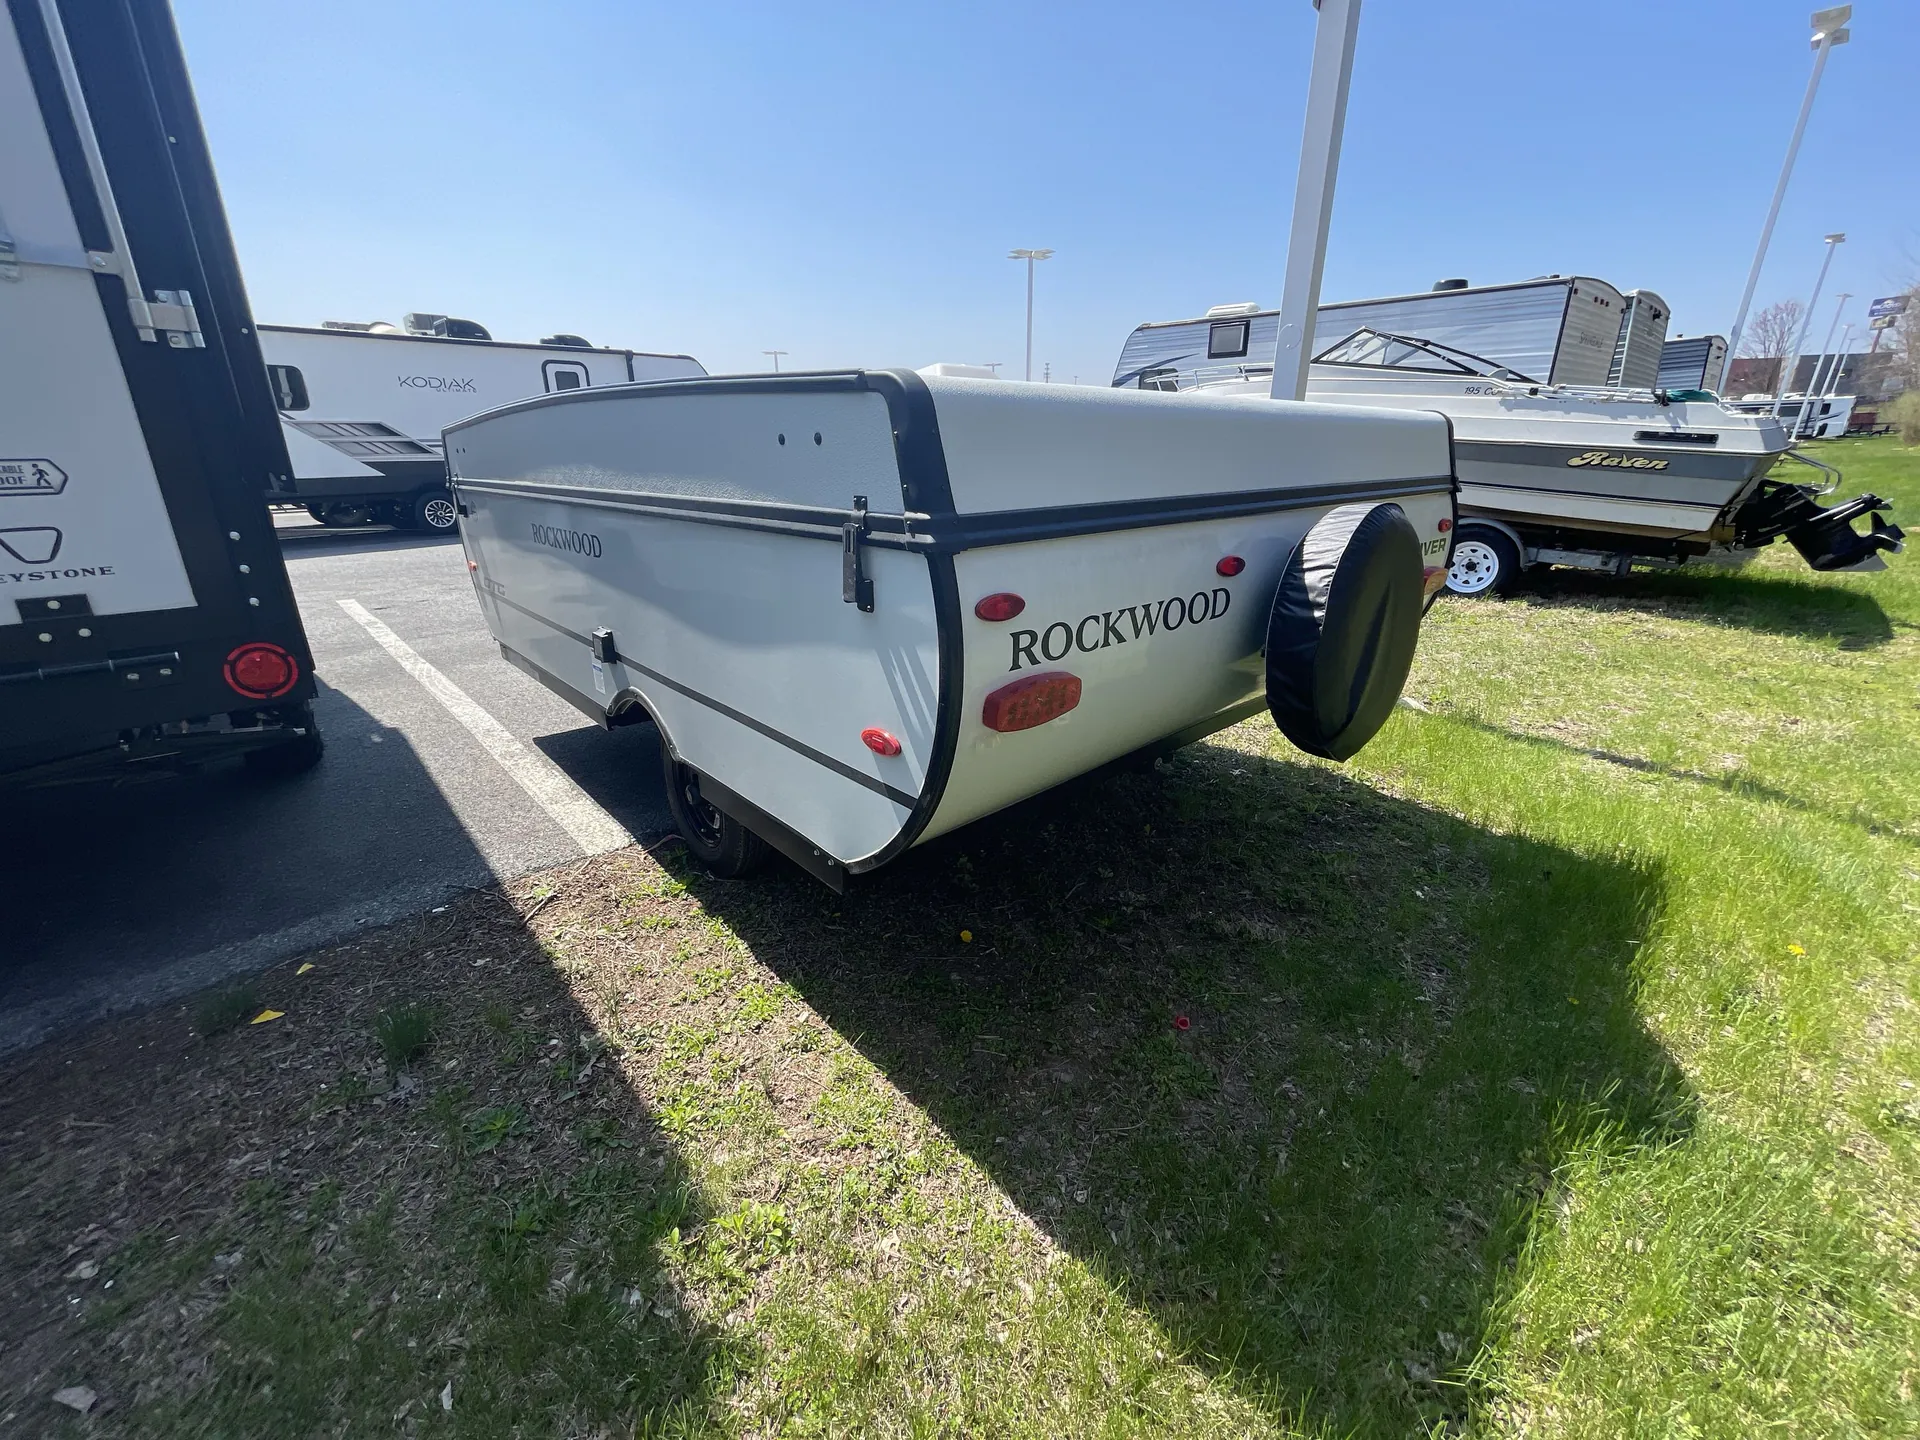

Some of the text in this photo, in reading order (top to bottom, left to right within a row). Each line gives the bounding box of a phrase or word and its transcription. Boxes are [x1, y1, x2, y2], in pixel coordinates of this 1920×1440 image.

[398, 376, 476, 390] KODIAK
[1464, 386, 1482, 395] 195
[1566, 451, 1670, 470] Raven
[0, 465, 24, 474] ABLE
[530, 522, 602, 558] ROCKWOOD
[1008, 587, 1231, 672] ROCKWOOD
